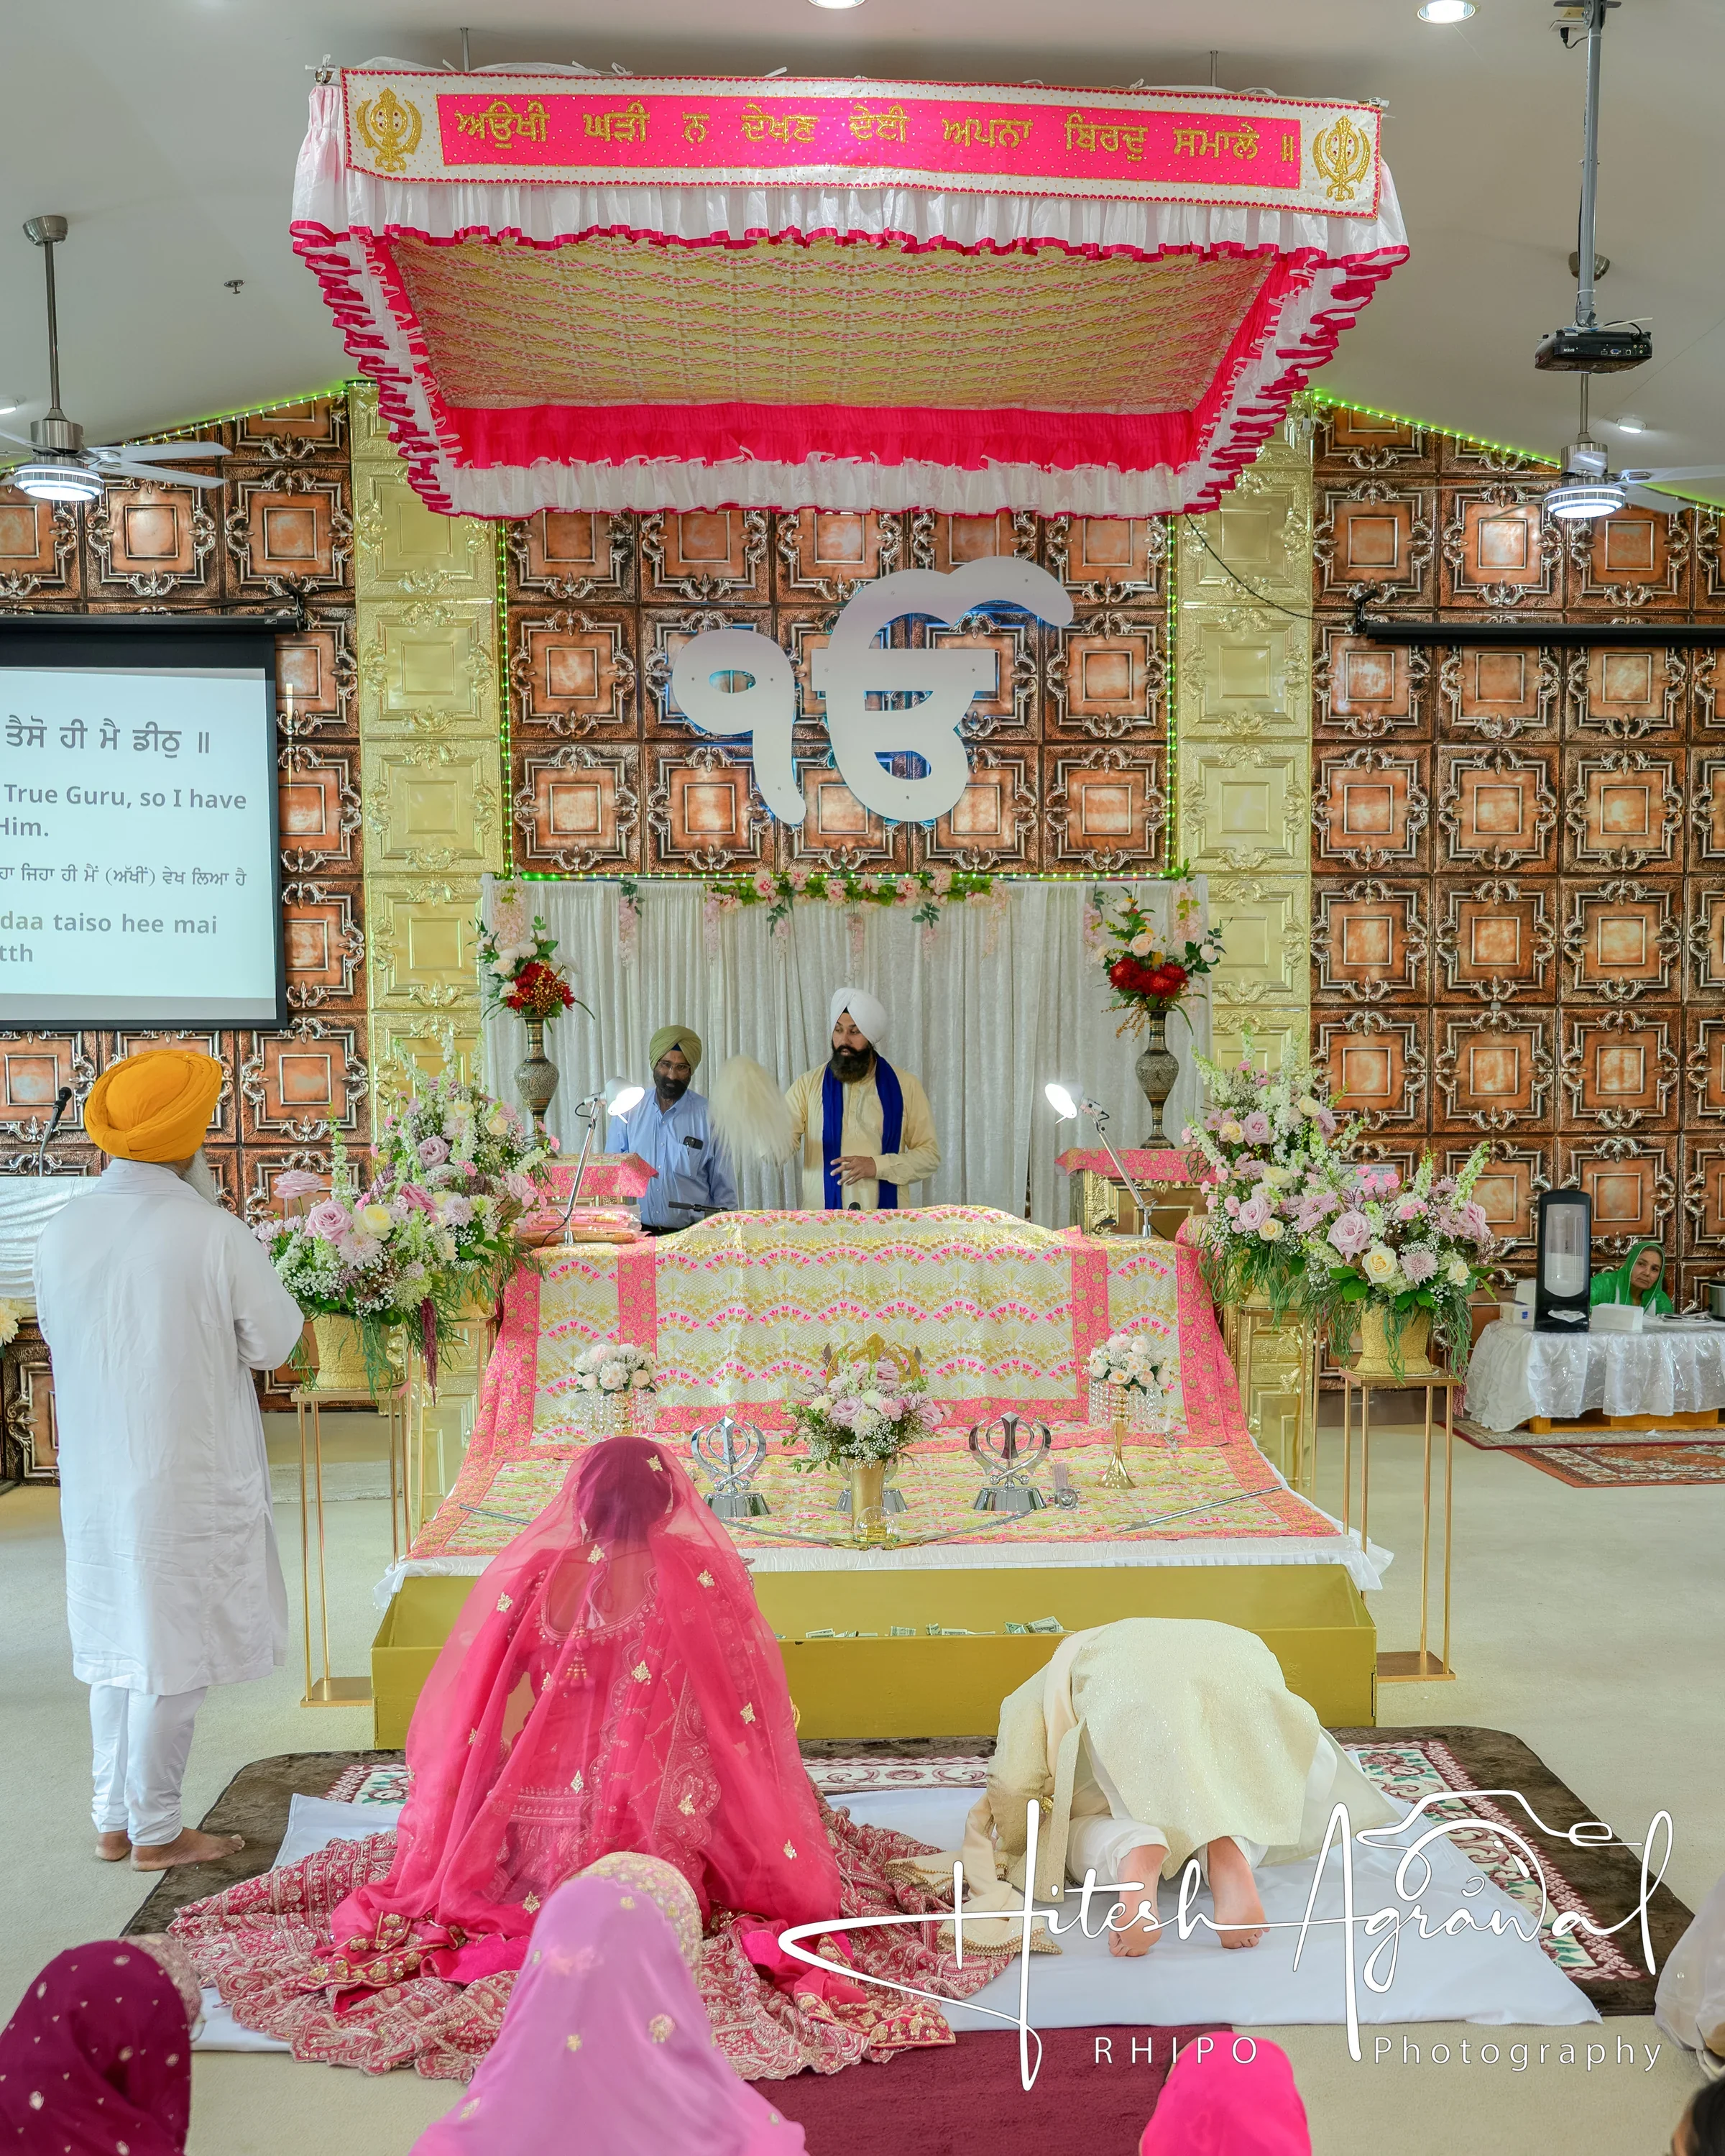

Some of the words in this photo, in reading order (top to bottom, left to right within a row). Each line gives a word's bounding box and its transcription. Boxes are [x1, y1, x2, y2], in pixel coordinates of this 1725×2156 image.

[582, 101, 650, 142] ਘੜੀ
[682, 113, 710, 144] ਨ
[741, 103, 818, 144] ਦੇਖਣ
[848, 104, 911, 144] ਦੇਈ
[942, 117, 1034, 148] ਅਪਨਾ
[1064, 111, 1149, 161] ਬਿਰਦੁ
[1172, 121, 1259, 160] ਸਮਾਲੇ
[5, 714, 47, 748] ਤੈਸੋ
[59, 718, 88, 749] ਹੀ
[99, 717, 121, 751] ਮੈ
[132, 721, 182, 758] ਡੀਠੁ
[4, 784, 58, 804] True
[66, 786, 132, 809] Guru,
[140, 792, 165, 807] so
[173, 789, 182, 808] I
[190, 789, 247, 809] have
[0, 816, 49, 837] Him.
[21, 863, 55, 881] ਜਿਹਾ
[61, 864, 78, 882] ਹੀ
[84, 863, 99, 883] ਮੈਂ
[162, 866, 186, 885] ਵੇਖ
[192, 867, 230, 886] ਲਿਆ
[235, 867, 247, 886] ਹੈ
[1, 910, 43, 930] daa
[53, 912, 111, 932] taiso
[122, 913, 164, 933] hee
[175, 915, 217, 934] mai
